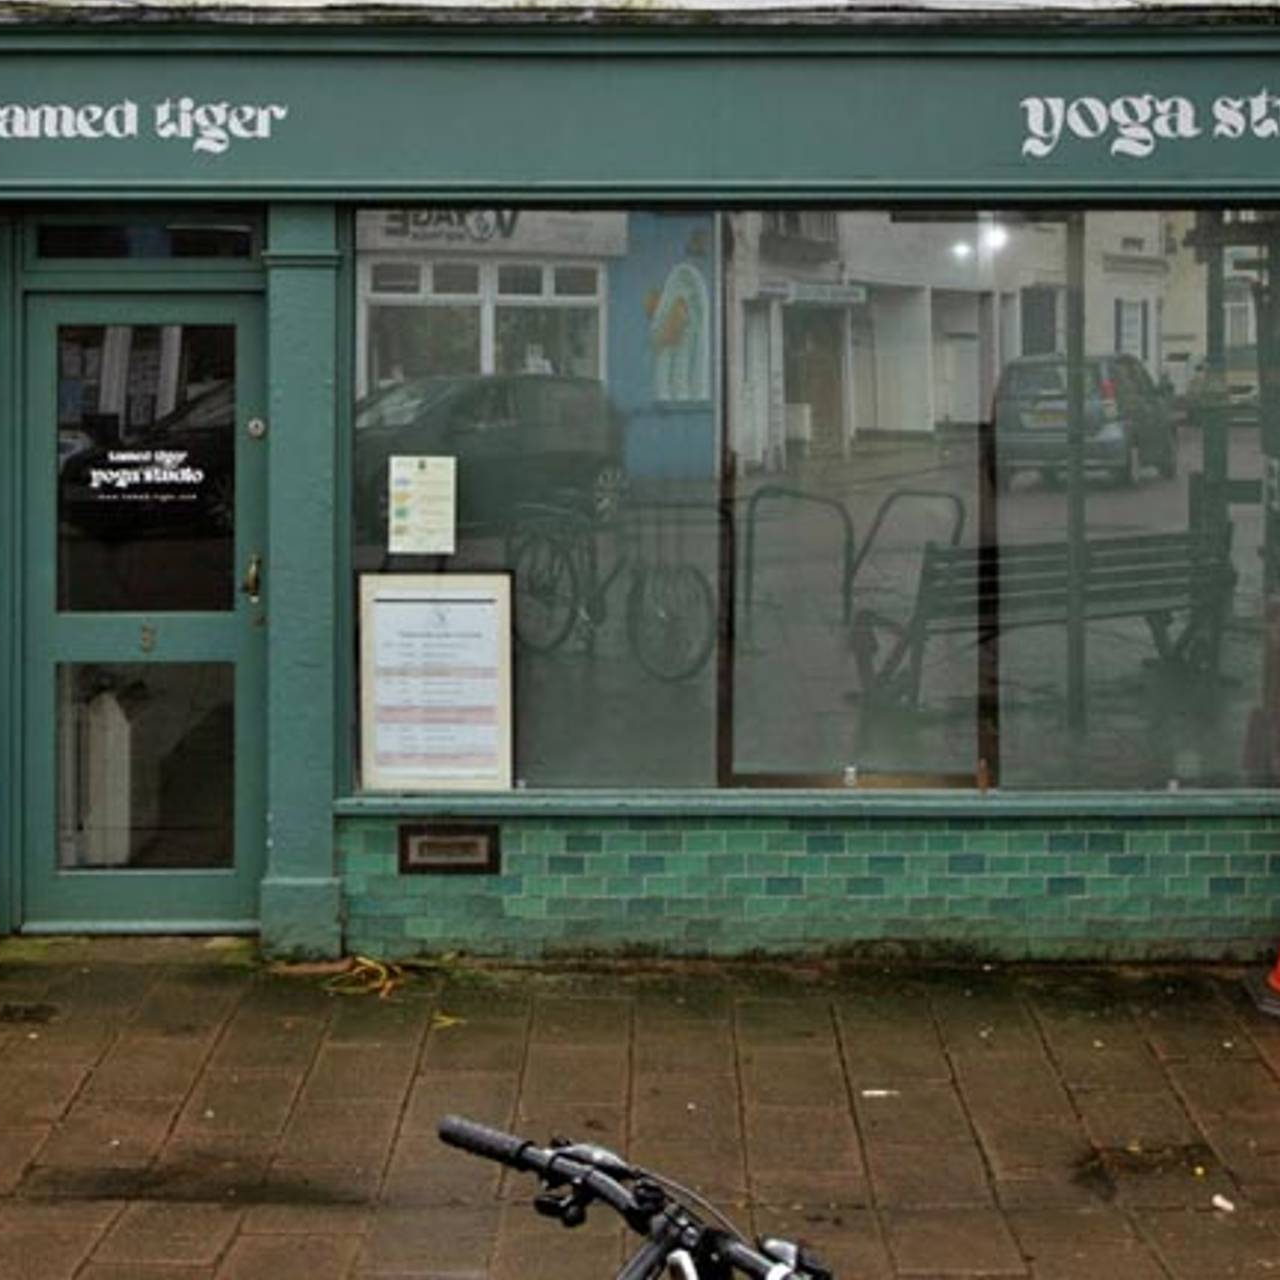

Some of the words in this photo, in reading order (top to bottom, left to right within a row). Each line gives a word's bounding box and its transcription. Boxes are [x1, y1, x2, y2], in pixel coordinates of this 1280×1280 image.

[154, 97, 289, 154] tiger
[1019, 92, 1203, 158] yoga
[89, 468, 142, 489] yoga
[142, 465, 205, 485] studio
